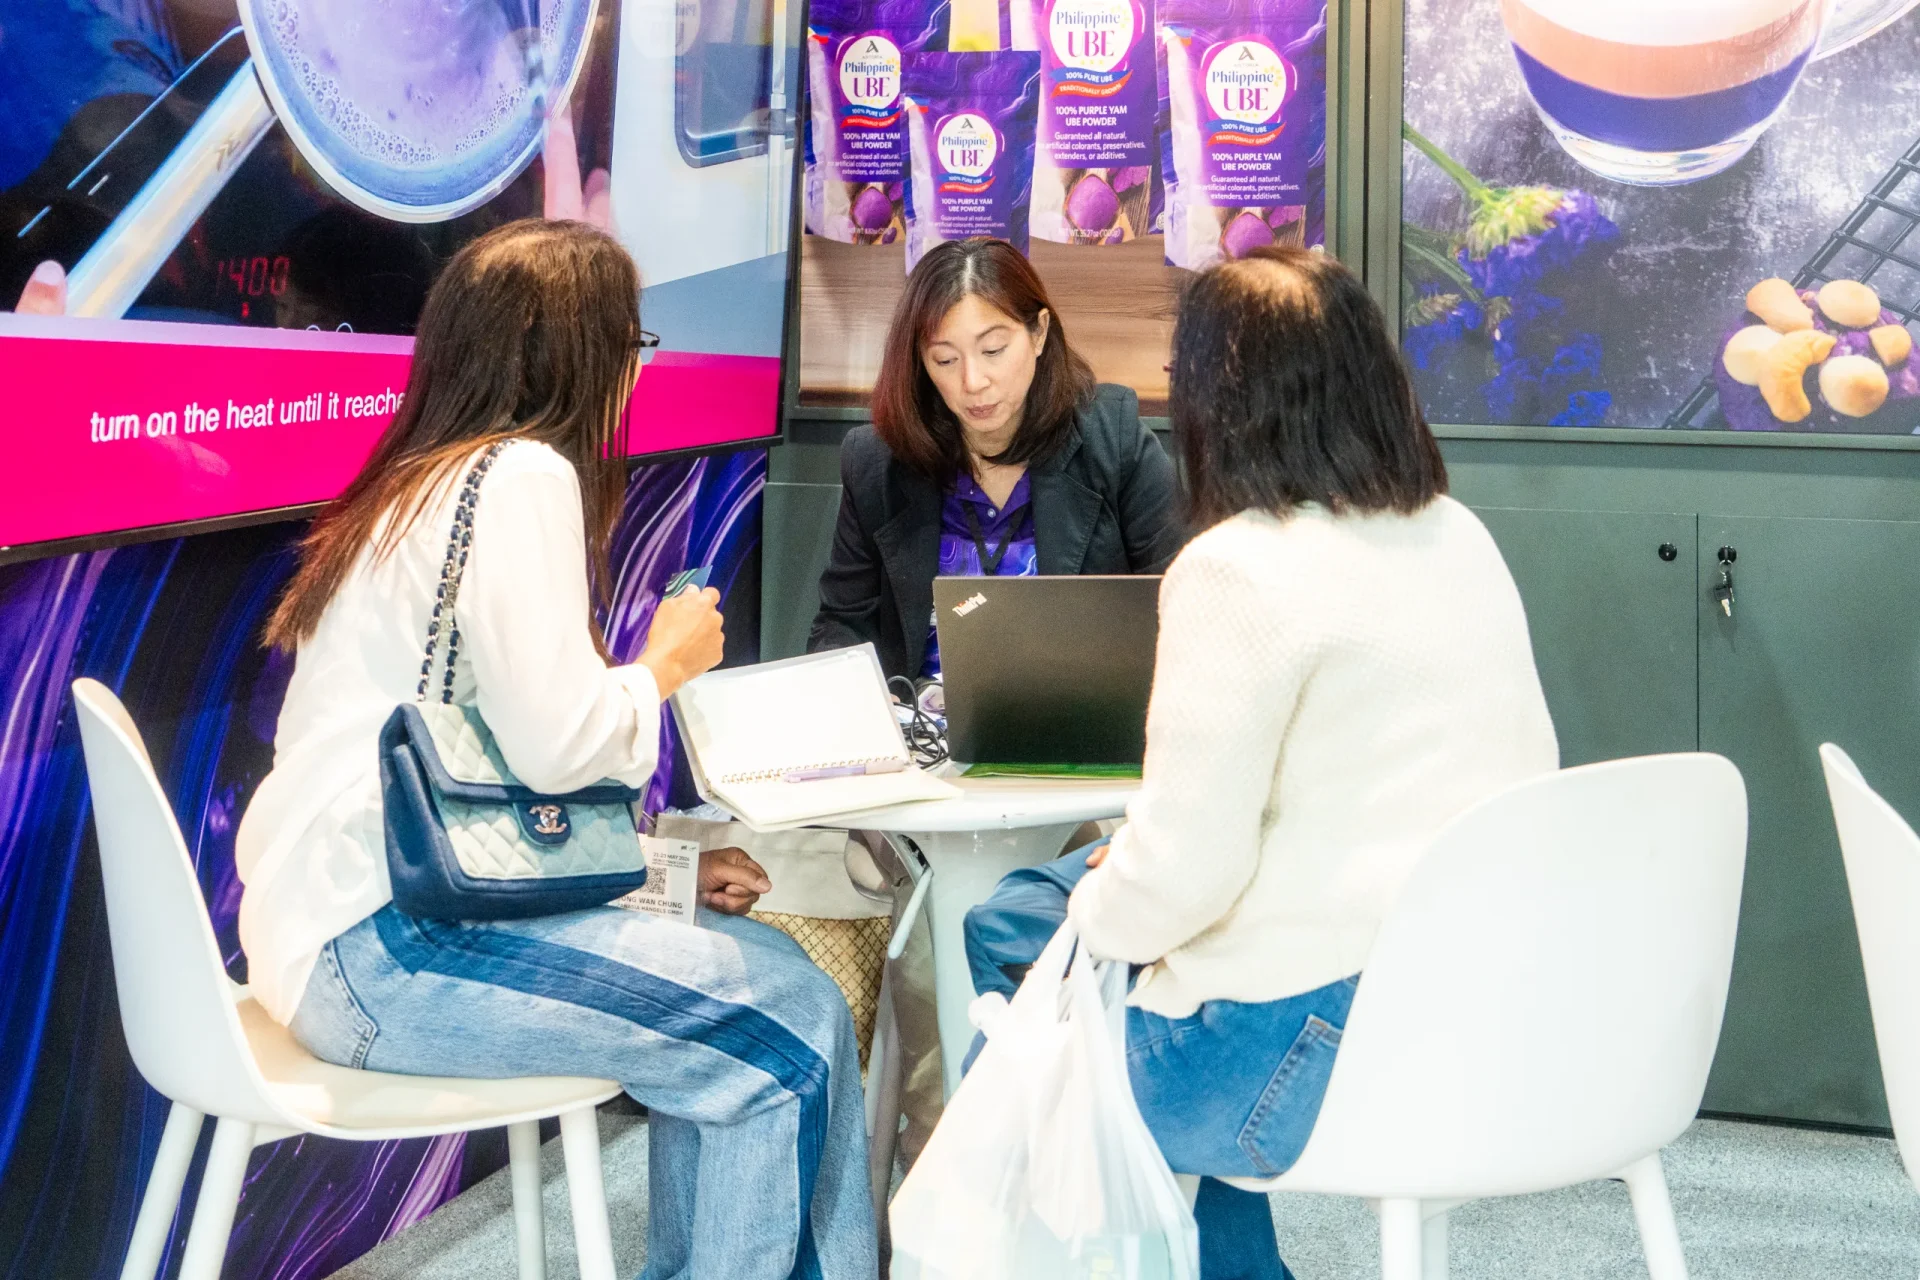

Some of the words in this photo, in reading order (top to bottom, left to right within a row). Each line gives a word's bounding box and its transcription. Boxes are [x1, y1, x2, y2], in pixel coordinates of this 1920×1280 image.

[1057, 11, 1120, 28] Philippine
[1068, 31, 1115, 57] UBE
[845, 62, 894, 75] Philippine
[1084, 73, 1099, 82] PURE
[1212, 71, 1274, 86] Philippine
[854, 77, 890, 97] UBE
[1224, 88, 1268, 111] UBE
[1056, 106, 1077, 115] 100%
[1079, 106, 1108, 115] PURPLE
[1109, 105, 1127, 114] YAM
[1066, 118, 1081, 126] UBE
[1082, 117, 1116, 126] POWDER
[942, 136, 987, 148] Philippine
[1055, 132, 1092, 140] Guaranteed
[1072, 142, 1102, 150] colorants,
[950, 149, 983, 167] UBE
[1054, 152, 1087, 160] extenders,
[91, 411, 139, 442] turn
[146, 411, 176, 438] on
[184, 402, 220, 434] the
[227, 398, 273, 429] heat
[280, 392, 322, 425] until
[328, 392, 339, 420] it
[658, 899, 683, 909] CHUNG
